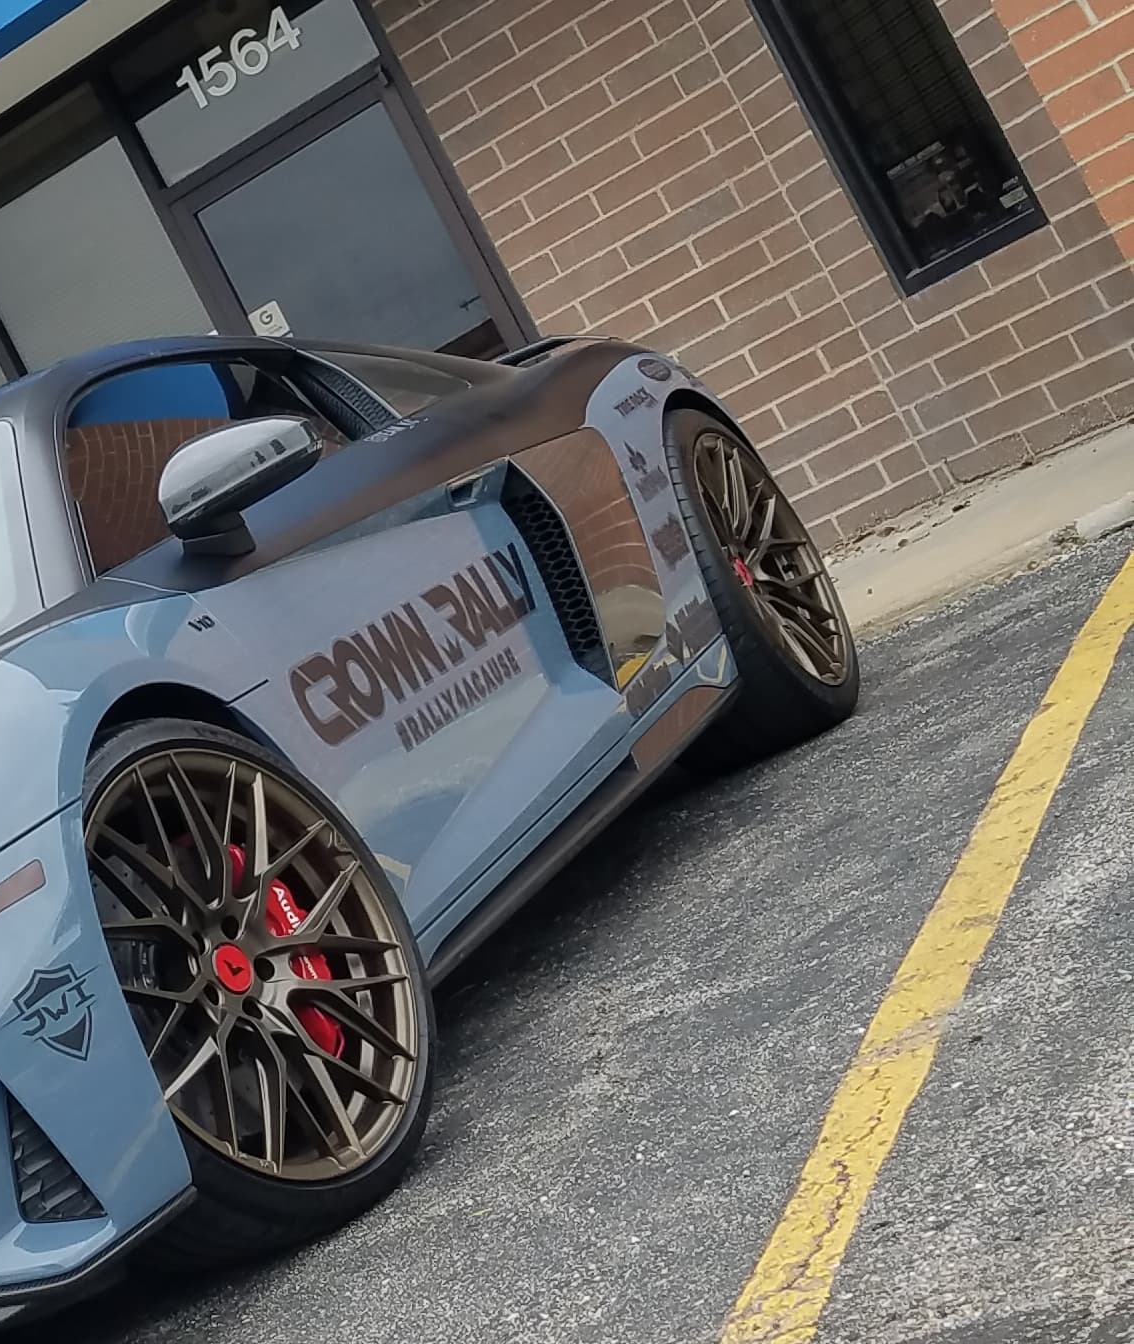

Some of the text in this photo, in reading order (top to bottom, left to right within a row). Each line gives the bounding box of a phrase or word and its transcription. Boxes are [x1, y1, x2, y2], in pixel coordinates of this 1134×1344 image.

[176, 6, 301, 109] 1564
[290, 602, 449, 747] CROWN
[420, 542, 536, 651] RALLY
[21, 978, 96, 1037] JWI
